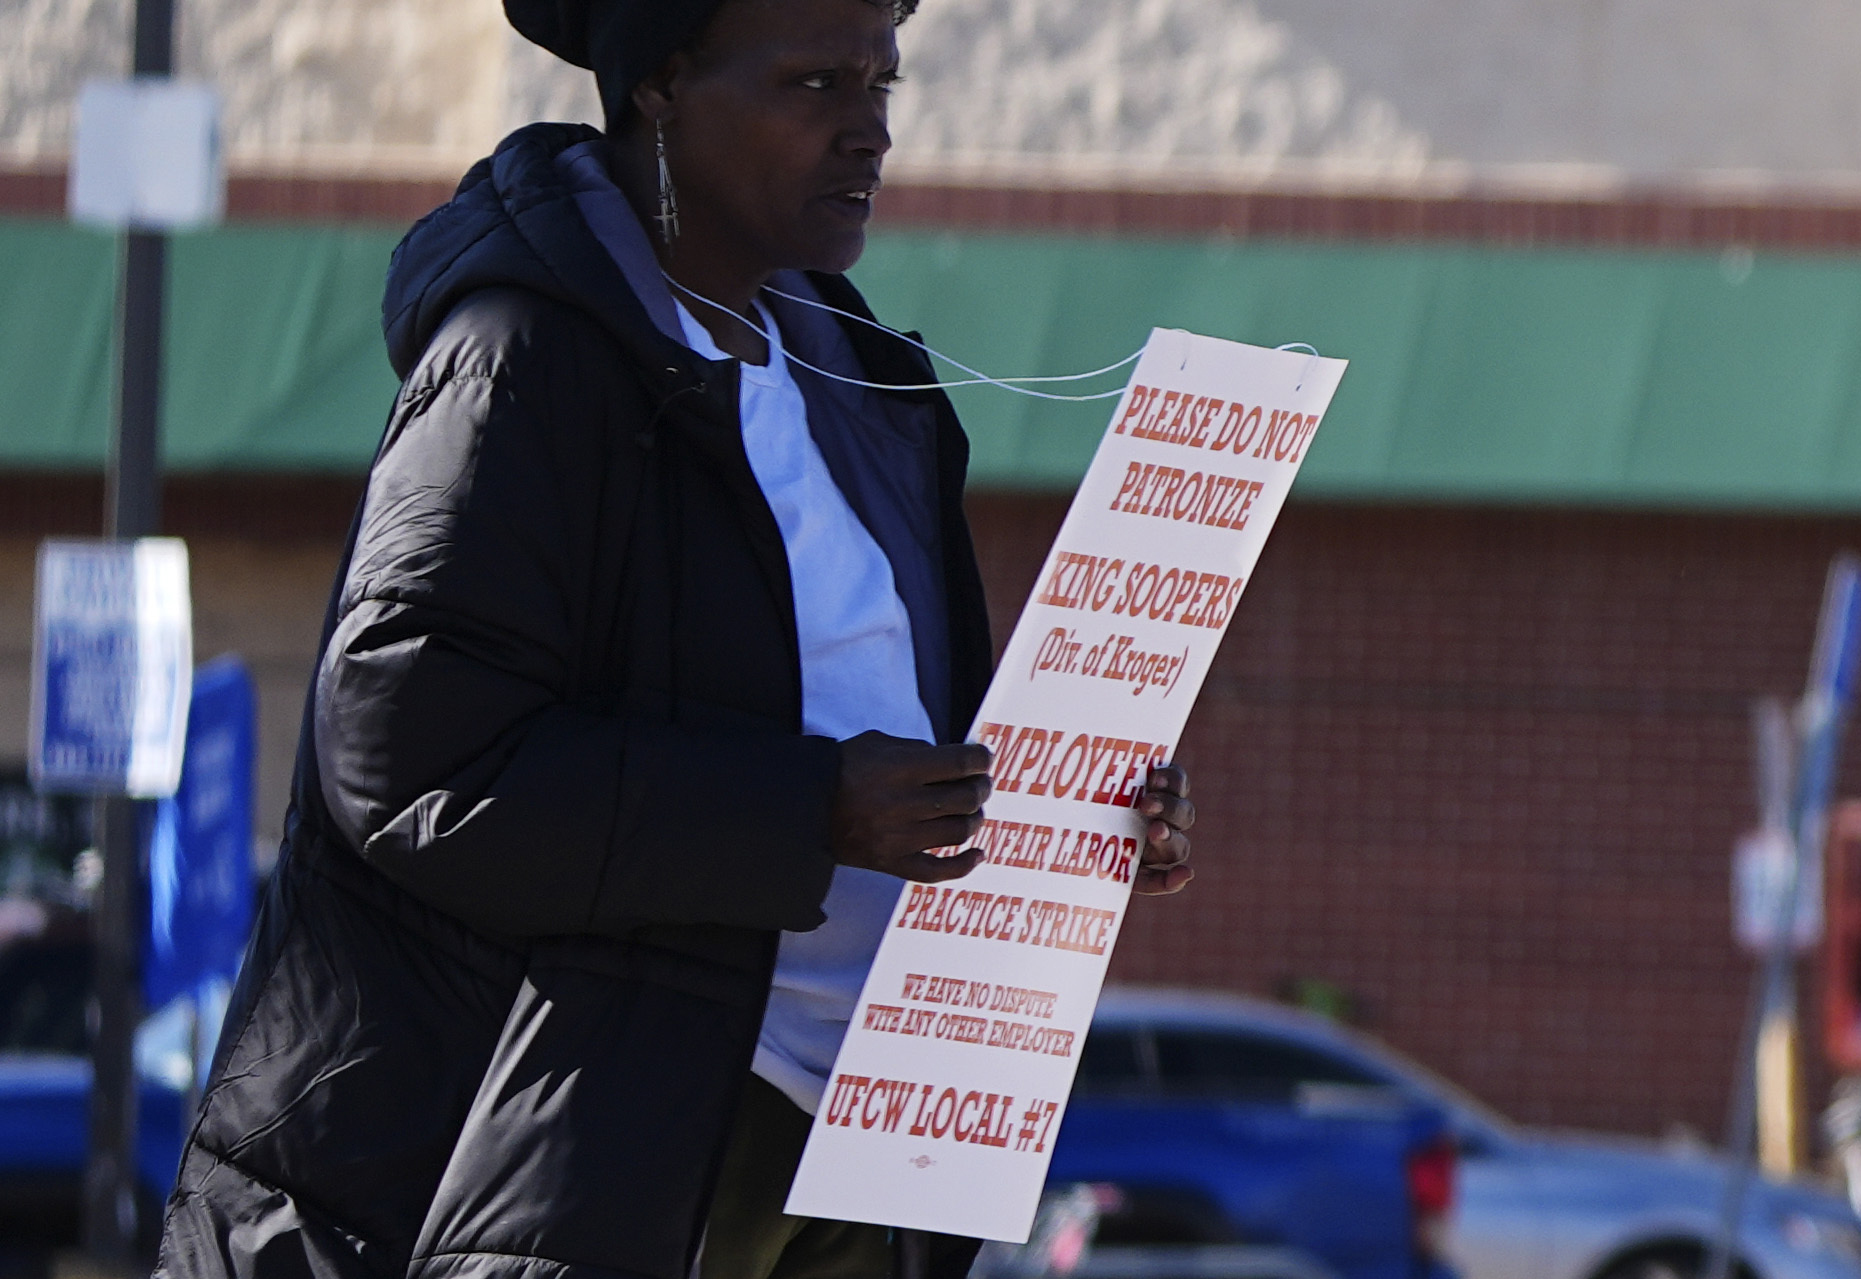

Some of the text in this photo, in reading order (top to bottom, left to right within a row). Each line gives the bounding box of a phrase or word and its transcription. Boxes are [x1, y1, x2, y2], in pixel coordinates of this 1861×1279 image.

[1114, 384, 1320, 464] PLEASE DO NOT
[1109, 460, 1265, 532] PATRONIZE
[1036, 550, 1126, 612] KING
[1030, 626, 1190, 699] (Div. of Kroger)
[1047, 828, 1138, 884] LABOR
[895, 884, 1117, 956] PRACTICE STRIKE
[862, 1003, 1076, 1058] WITH ANY OTHER EMPLOYER
[901, 973, 1059, 1019] WE HAVE NO DISPUTE
[825, 1073, 1060, 1153] UFCW LOCAL #7
